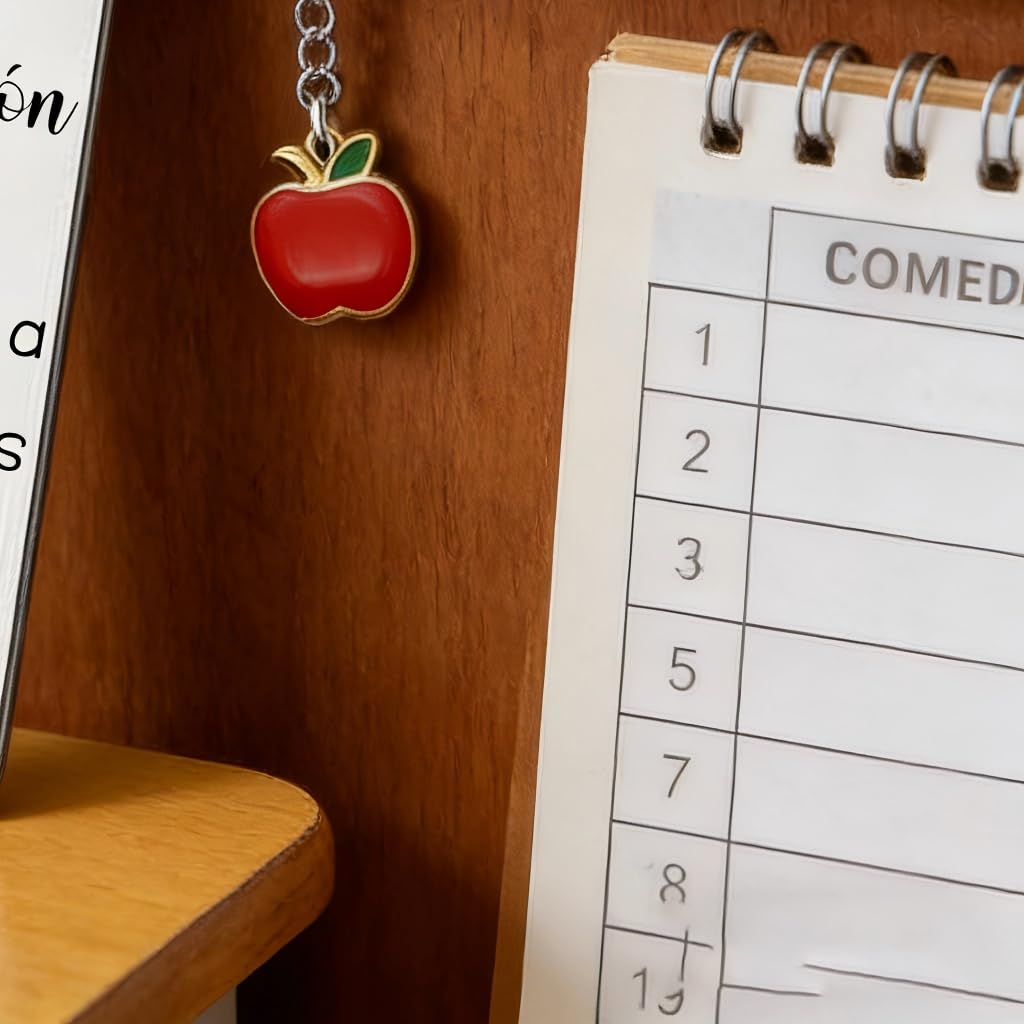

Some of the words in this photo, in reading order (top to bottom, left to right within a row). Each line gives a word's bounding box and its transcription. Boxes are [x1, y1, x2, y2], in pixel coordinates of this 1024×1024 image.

[825, 241, 1024, 306] COMED
[9, 320, 47, 359] a
[694, 322, 712, 367] 1
[681, 429, 711, 474] 2
[675, 536, 703, 581] 3
[668, 645, 697, 693] 5
[661, 753, 692, 799] 7
[659, 862, 687, 905] 8
